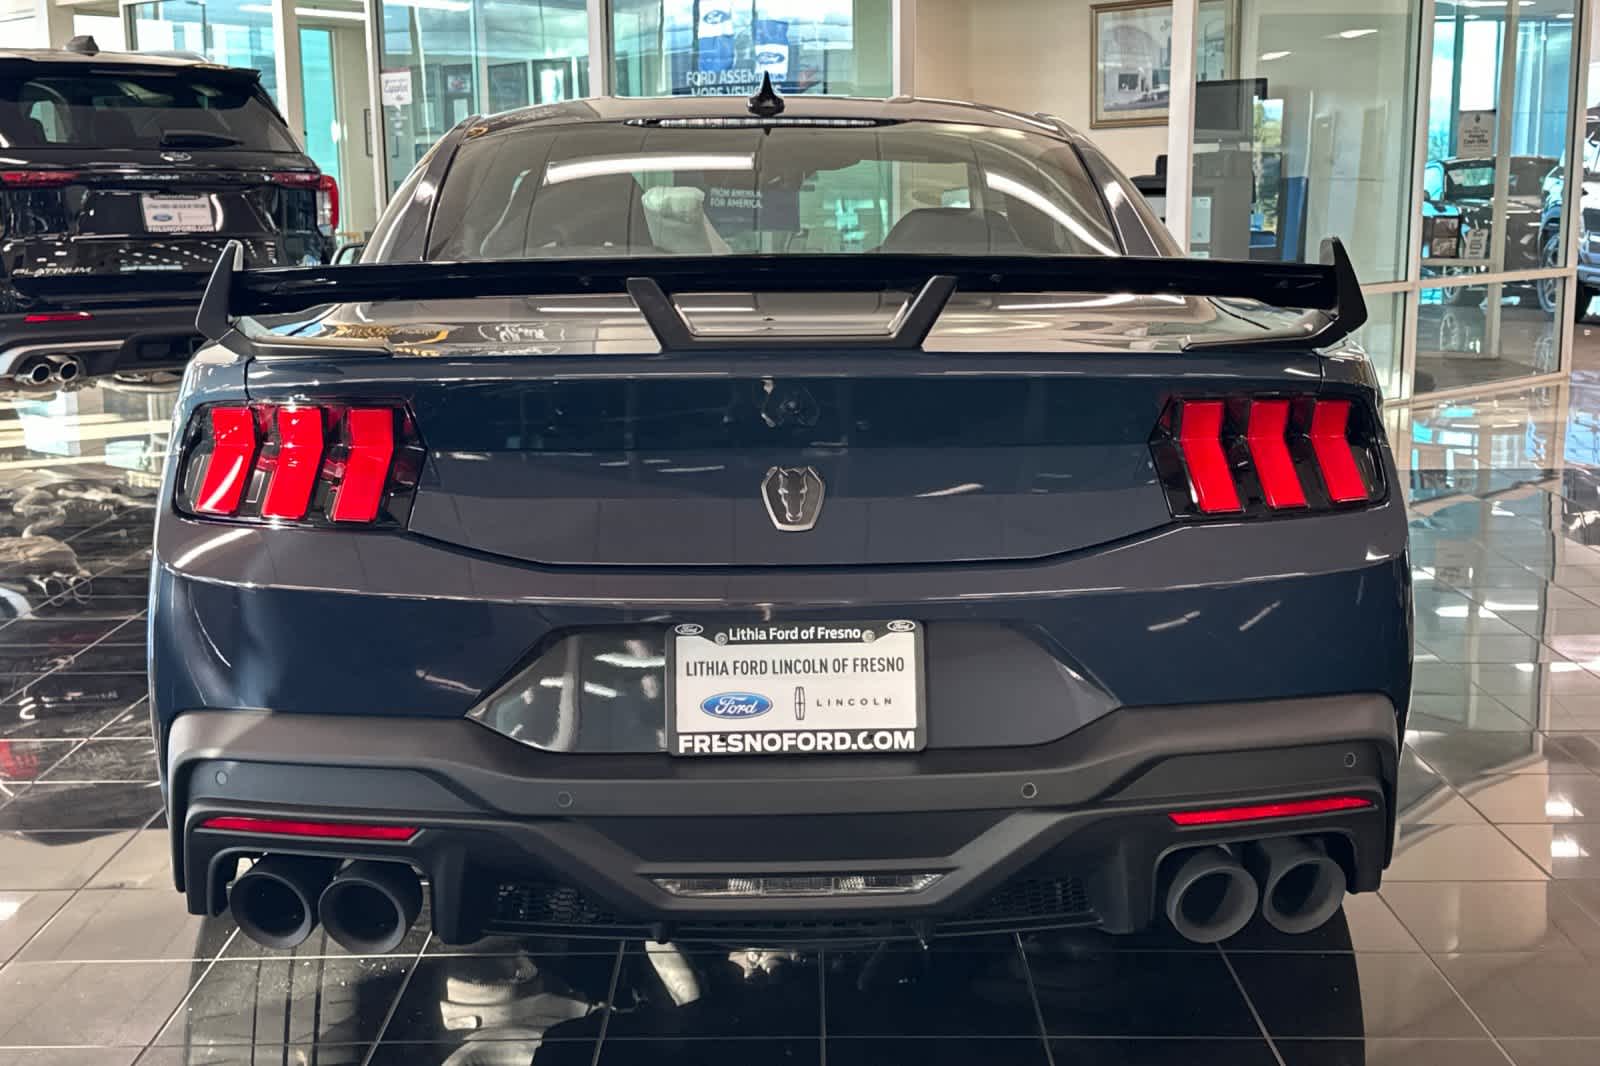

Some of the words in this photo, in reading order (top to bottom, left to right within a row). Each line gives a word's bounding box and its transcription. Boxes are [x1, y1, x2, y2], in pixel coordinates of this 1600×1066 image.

[685, 71, 717, 85] FORD
[710, 198, 726, 208] FOR
[12, 266, 93, 277] PLATINUM
[729, 627, 767, 641] Lithia
[769, 626, 798, 641] Ford
[800, 626, 815, 640] of
[817, 626, 861, 640] Fresno
[686, 660, 729, 676] LITHIA
[733, 659, 768, 676] FORD
[772, 657, 828, 675] LINCOLN
[832, 657, 849, 673] OF
[853, 656, 905, 673] FRESNO
[714, 695, 759, 716] Ford
[816, 697, 892, 707] LINCOLN
[678, 730, 916, 754] FRESNOFORD.COM
